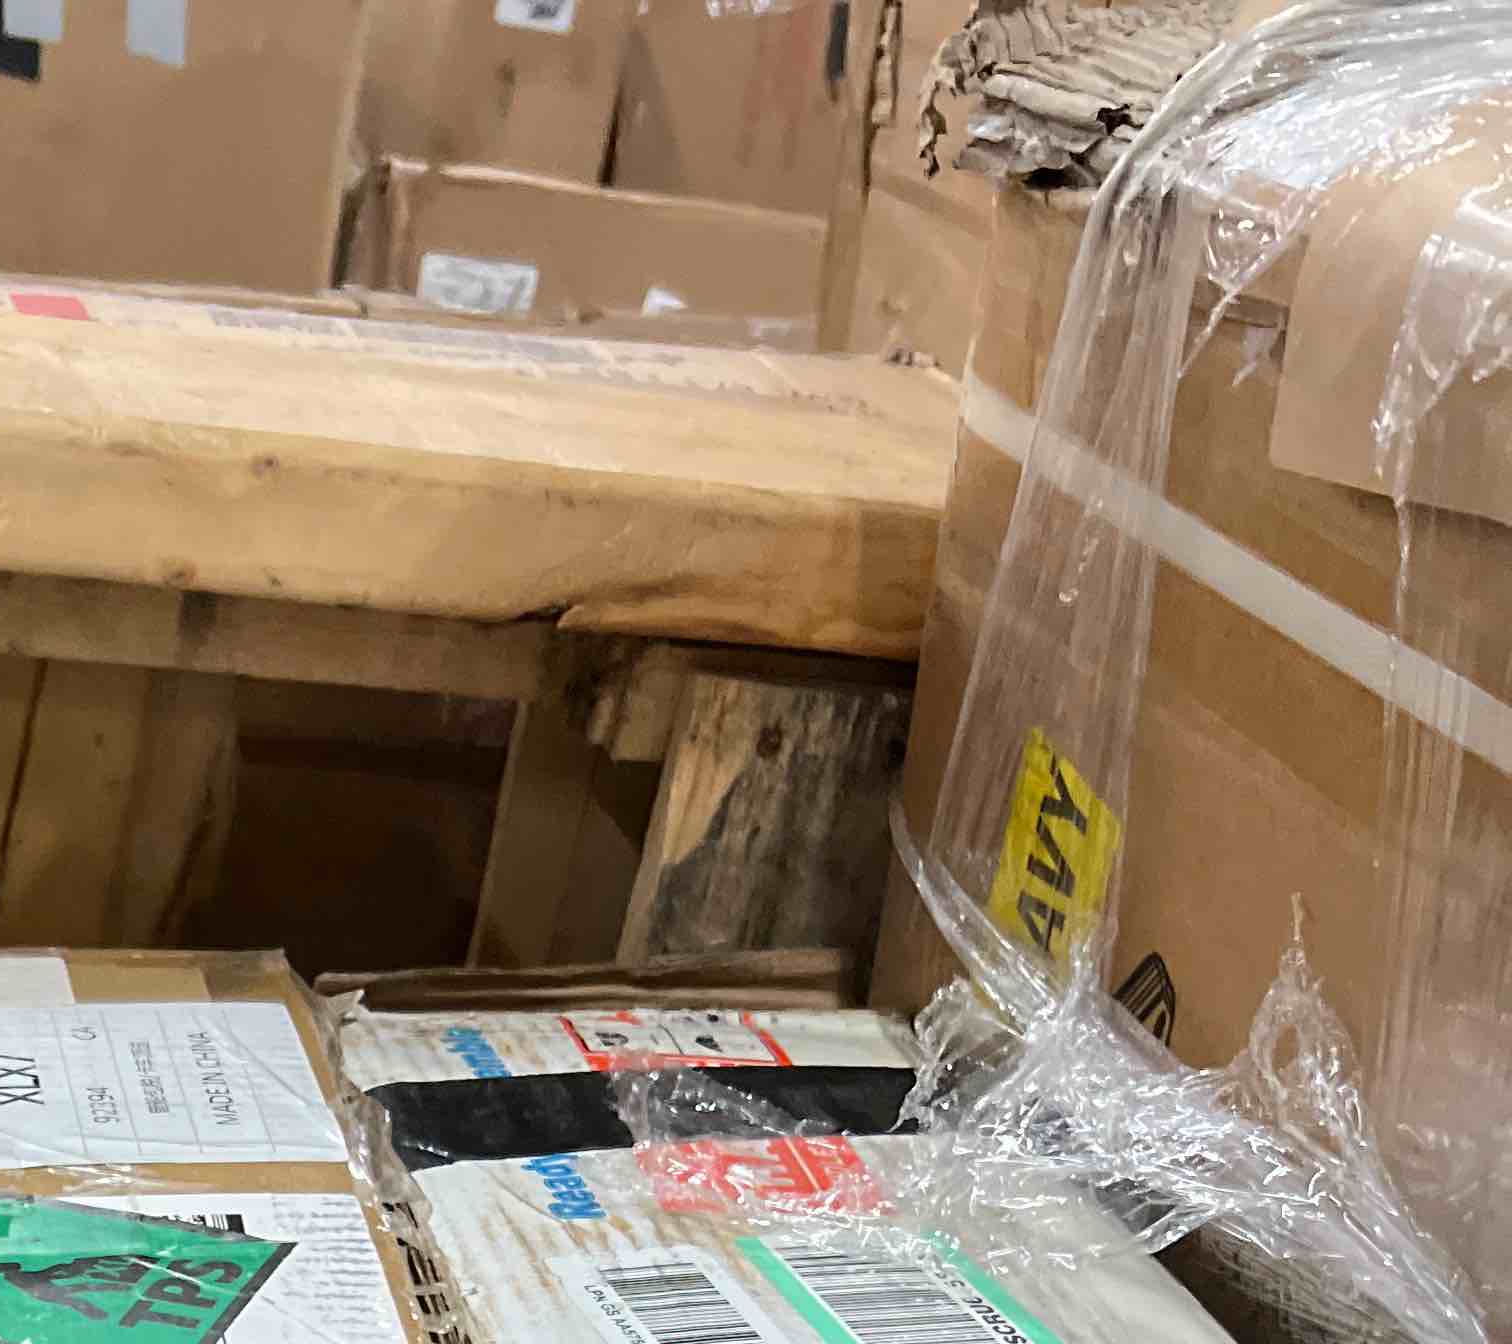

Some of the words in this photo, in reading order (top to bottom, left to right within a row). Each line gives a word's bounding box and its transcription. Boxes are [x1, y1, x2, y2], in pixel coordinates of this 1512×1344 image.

[1016, 752, 1088, 952] AVY
[187, 1031, 221, 1069] CHINA
[198, 1070, 225, 1086] IN
[207, 1088, 241, 1127] MADE
[119, 1258, 244, 1329] TPS
